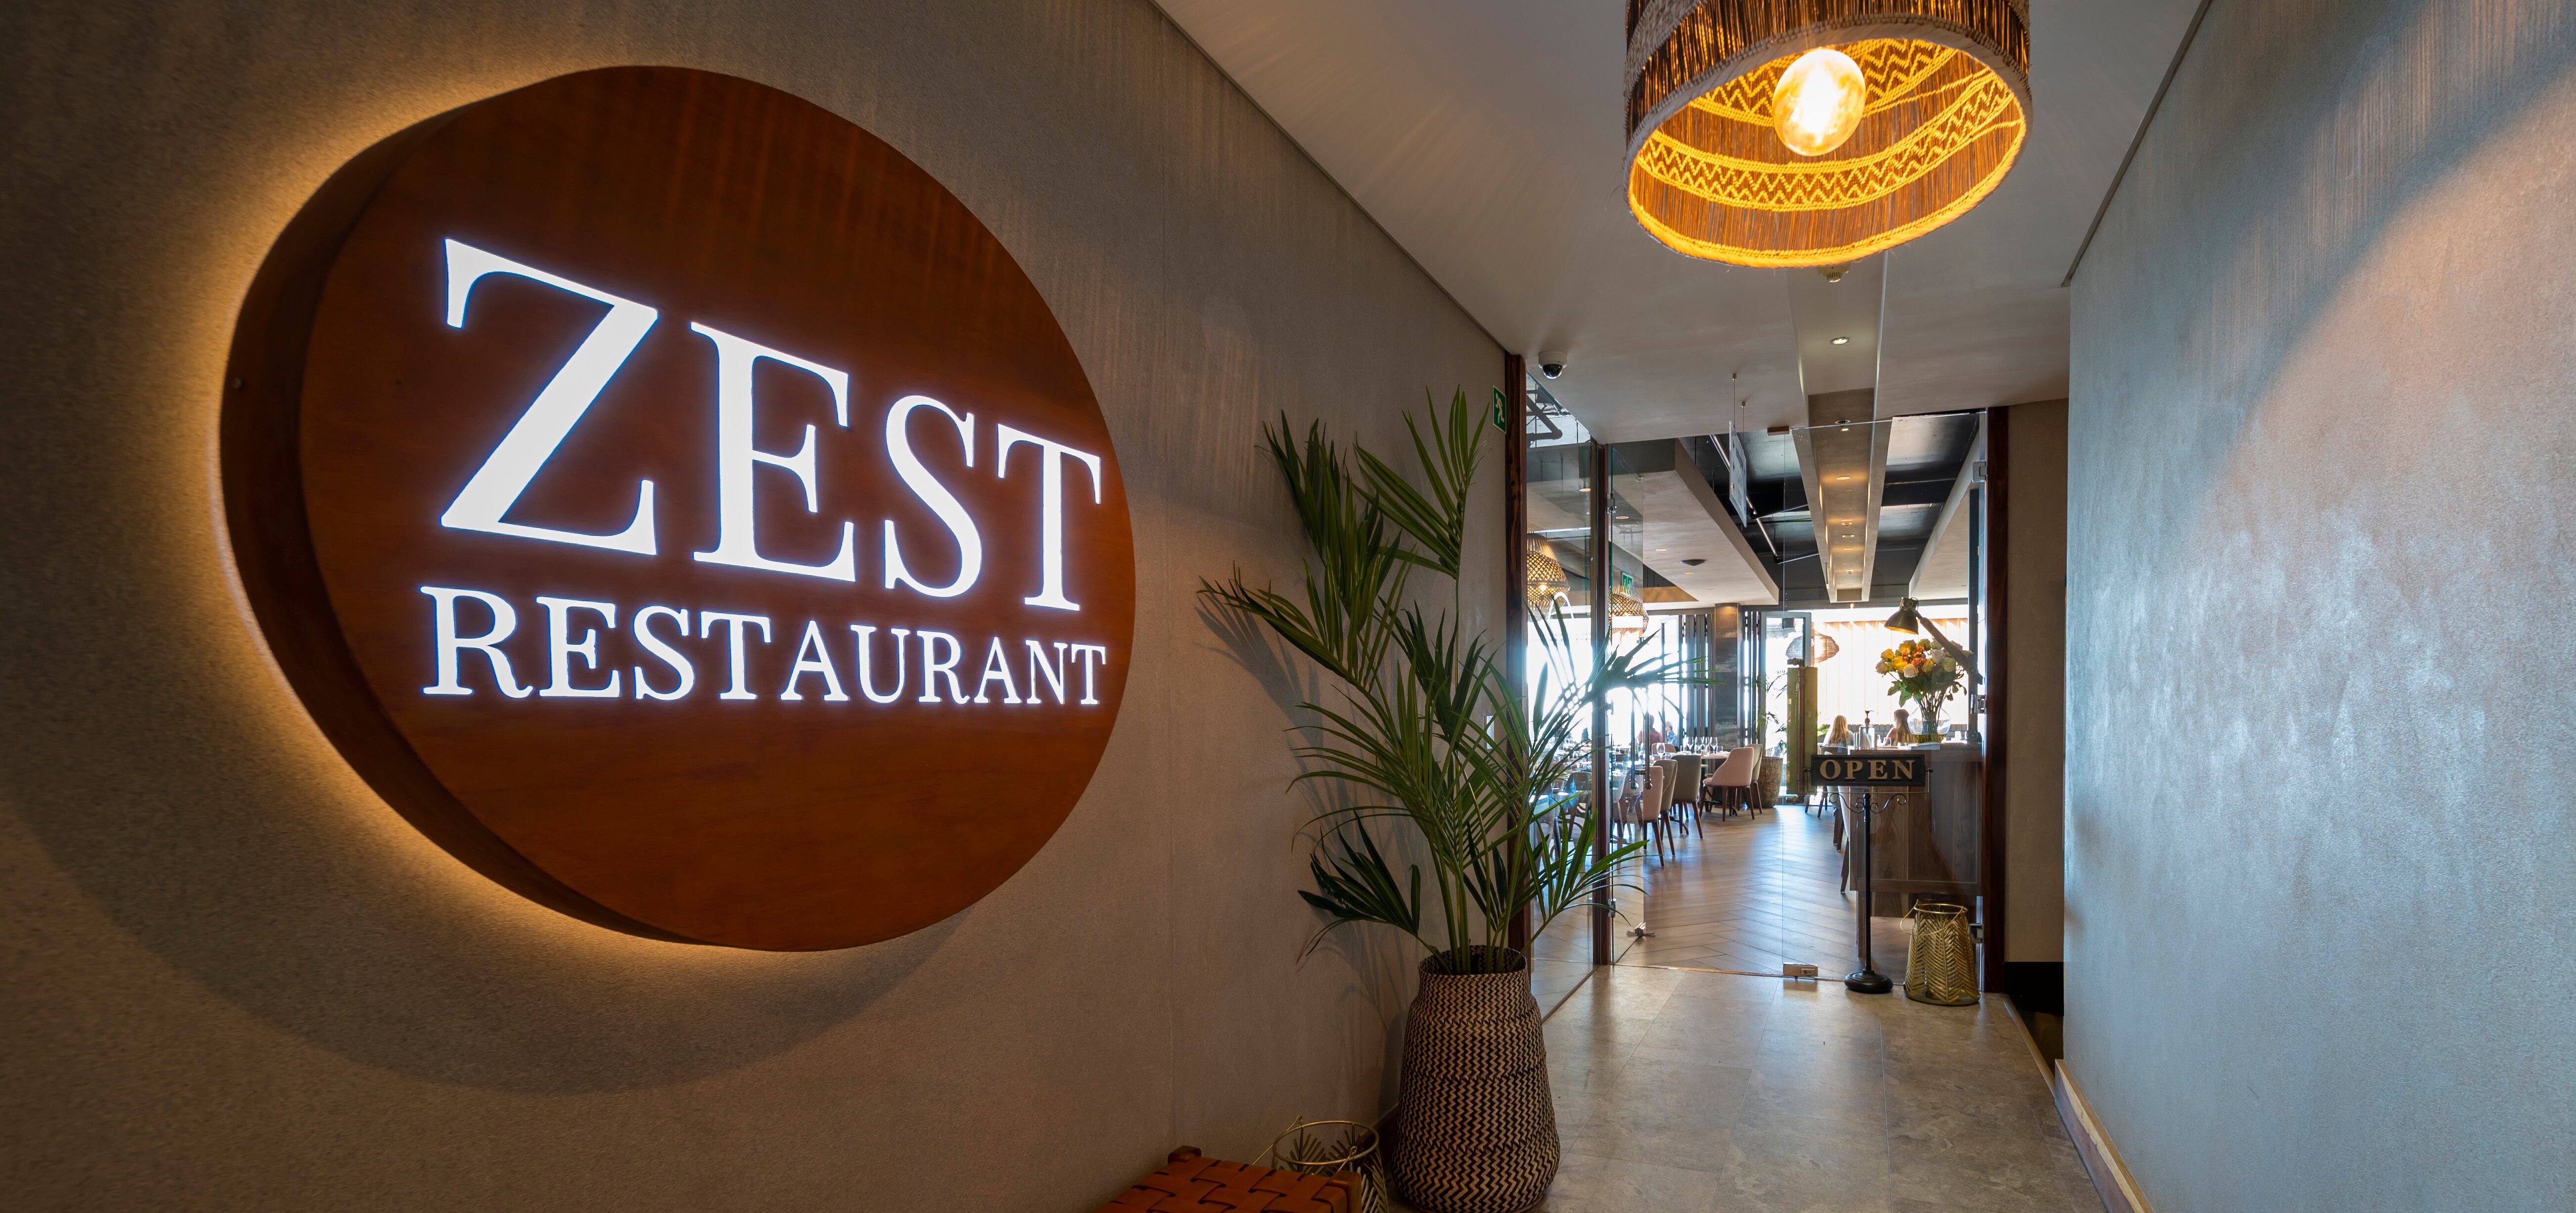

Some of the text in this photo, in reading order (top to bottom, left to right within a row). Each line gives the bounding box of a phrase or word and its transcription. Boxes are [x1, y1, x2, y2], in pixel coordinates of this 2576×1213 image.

[440, 238, 1102, 612] ZEST
[419, 585, 1107, 706] RESTAURANT
[1819, 759, 1915, 780] OPEN
